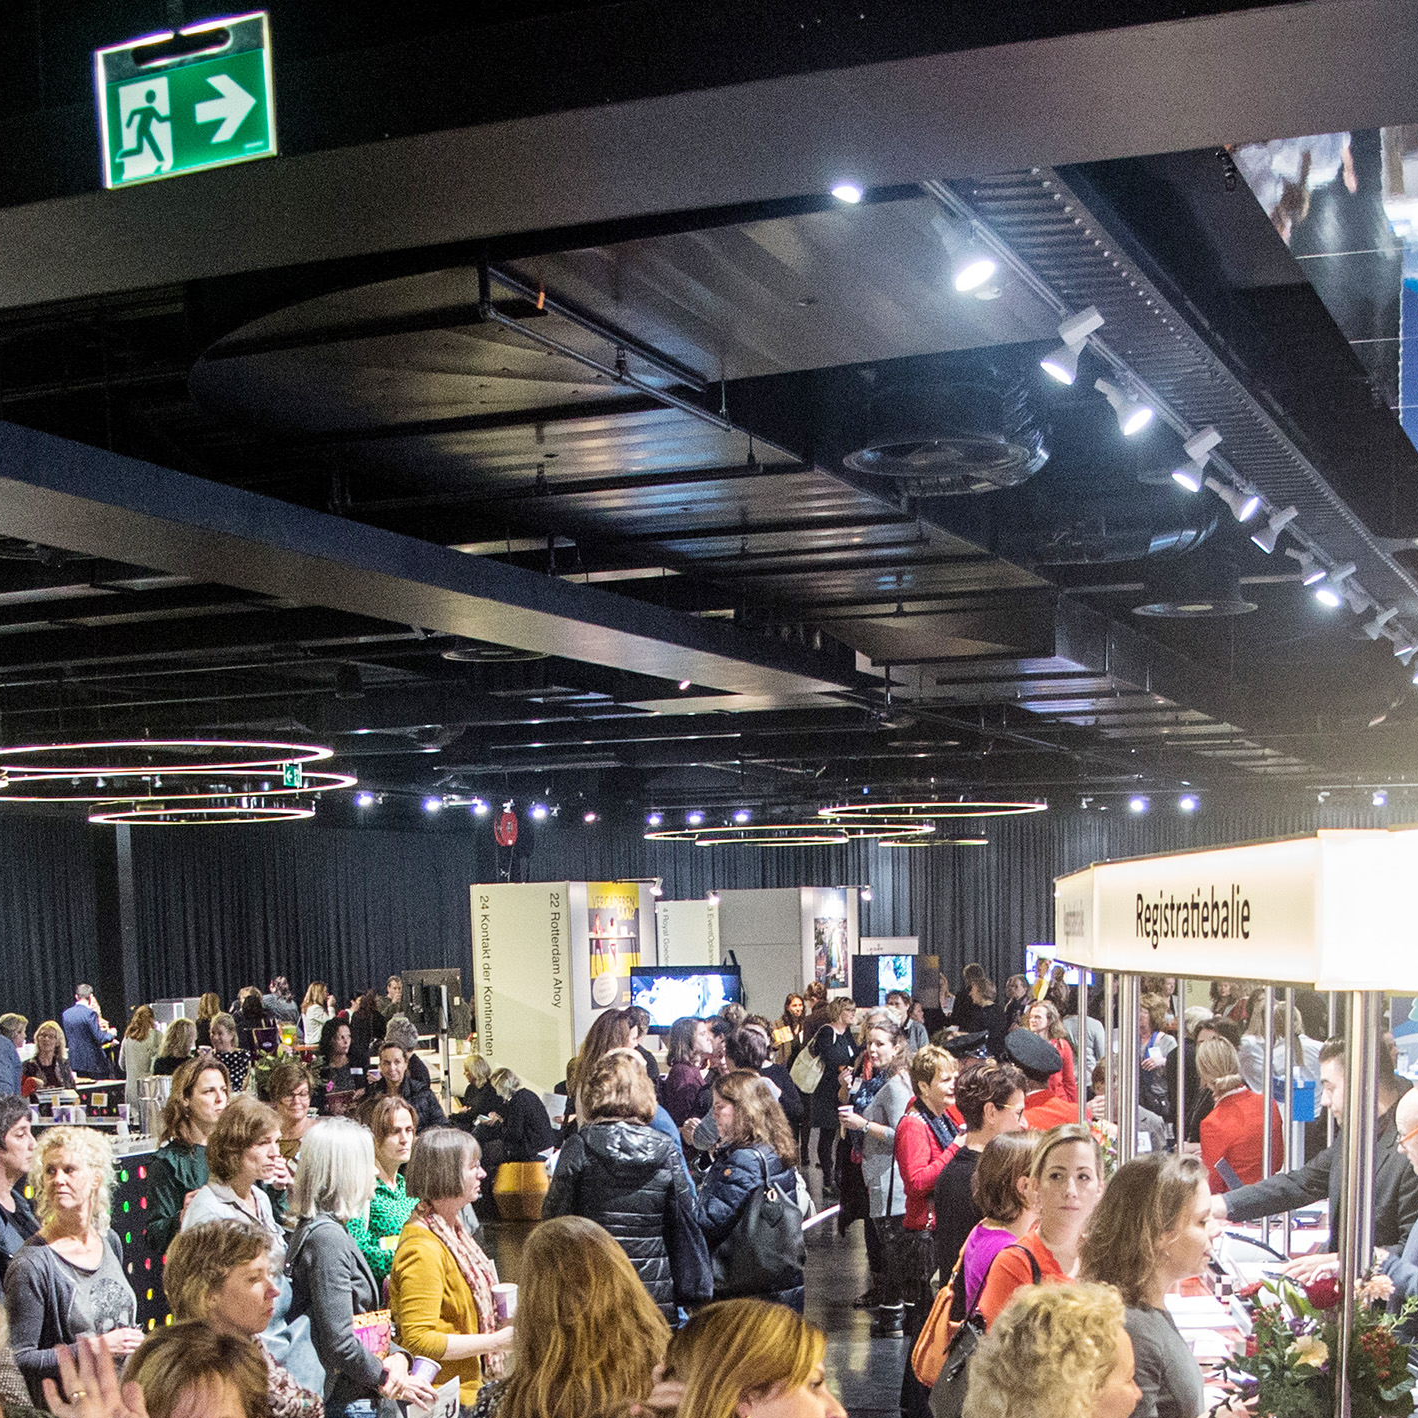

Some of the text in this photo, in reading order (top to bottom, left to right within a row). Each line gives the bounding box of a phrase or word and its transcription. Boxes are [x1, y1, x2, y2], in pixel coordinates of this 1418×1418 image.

[549, 892, 563, 1009] 22 Rotterdam Ahoy
[1135, 883, 1251, 950] Registratiebalie
[479, 895, 494, 1057] 24 Kontakt der Kontinenten
